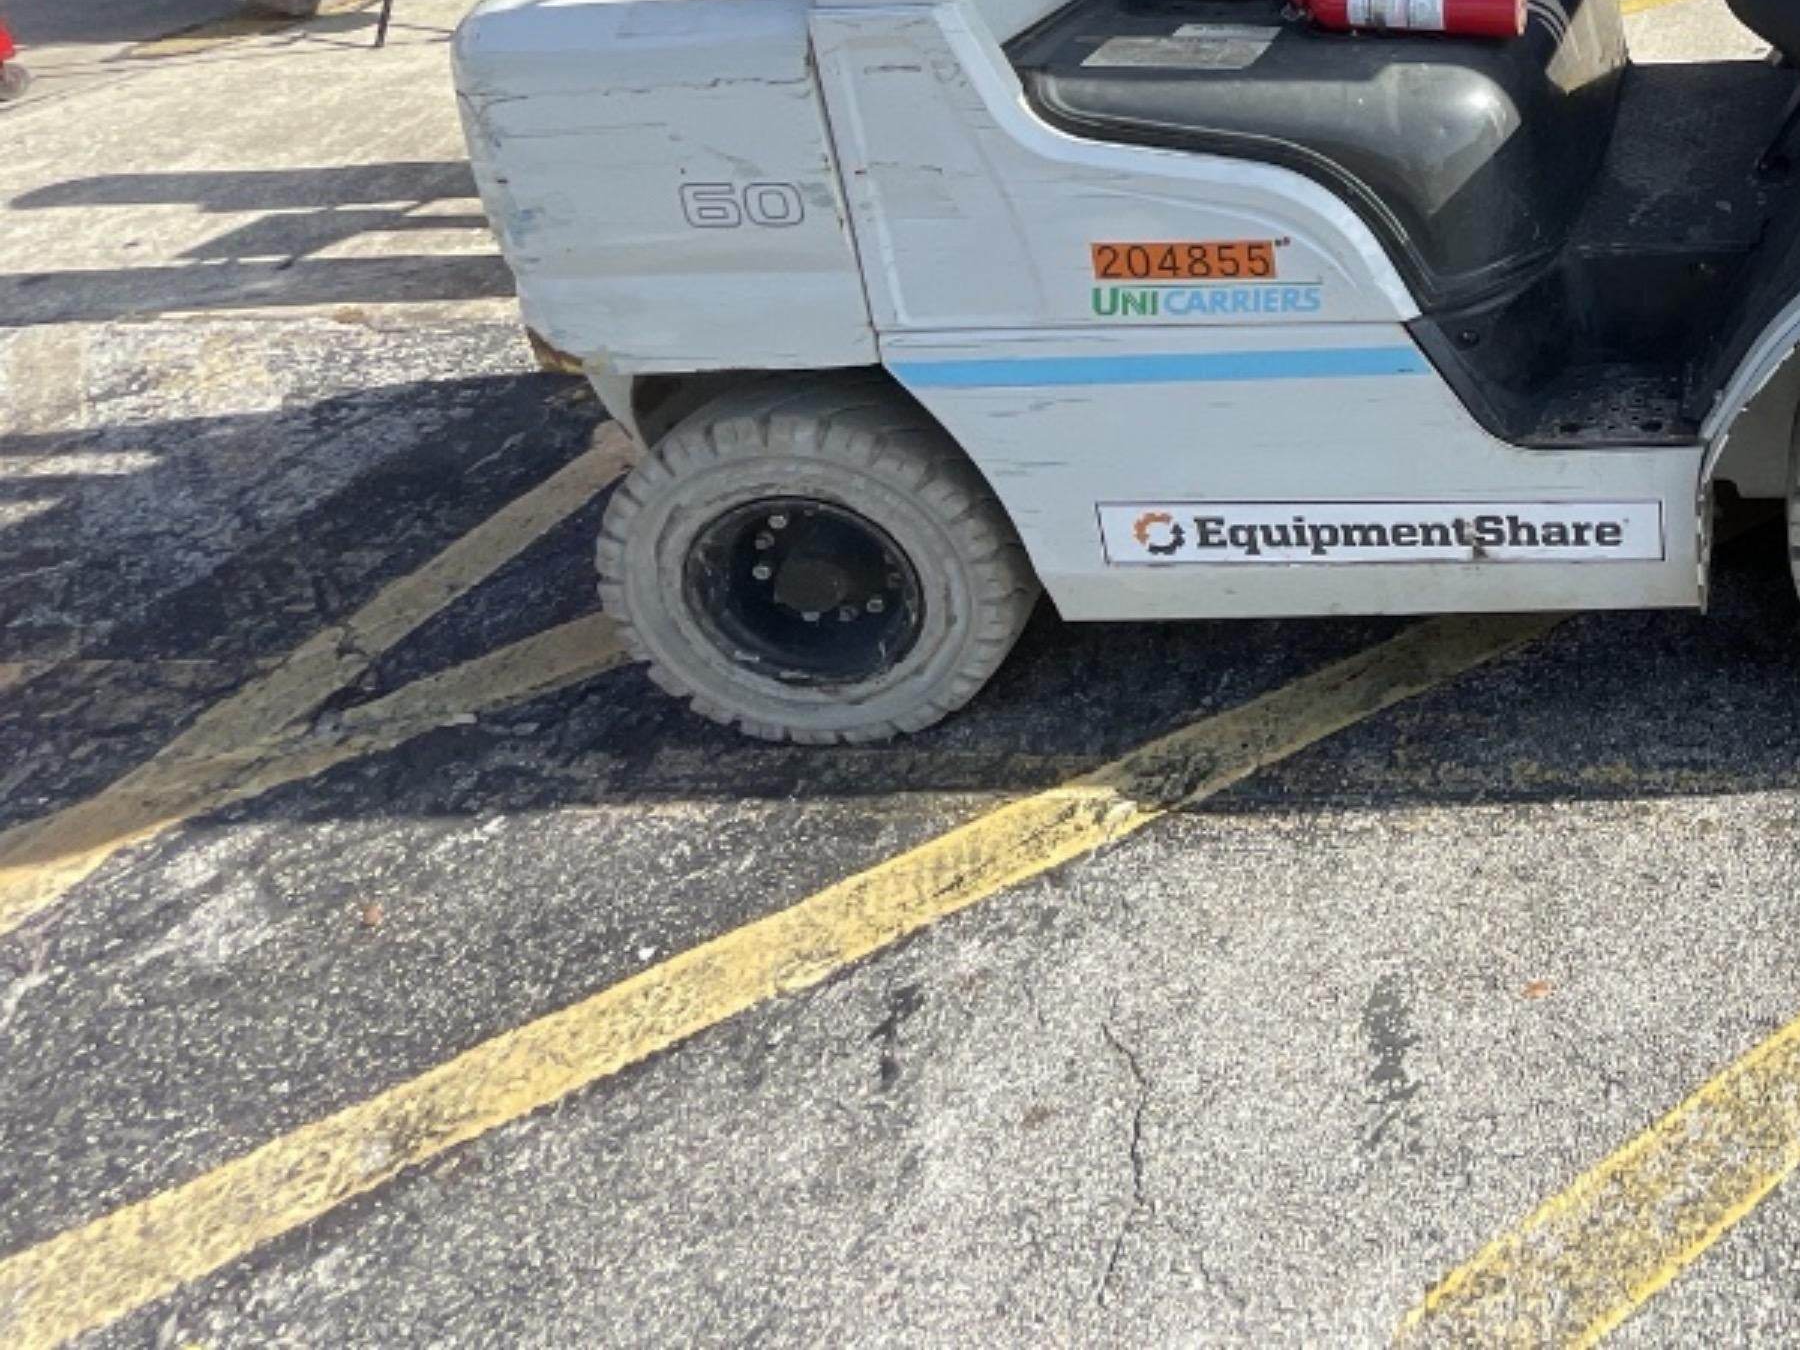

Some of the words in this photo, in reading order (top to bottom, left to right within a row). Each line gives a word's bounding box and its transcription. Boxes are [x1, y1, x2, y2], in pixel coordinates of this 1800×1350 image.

[679, 181, 805, 229] 60
[1096, 243, 1271, 278] 204855
[1193, 514, 1624, 555] EquipmentShare
